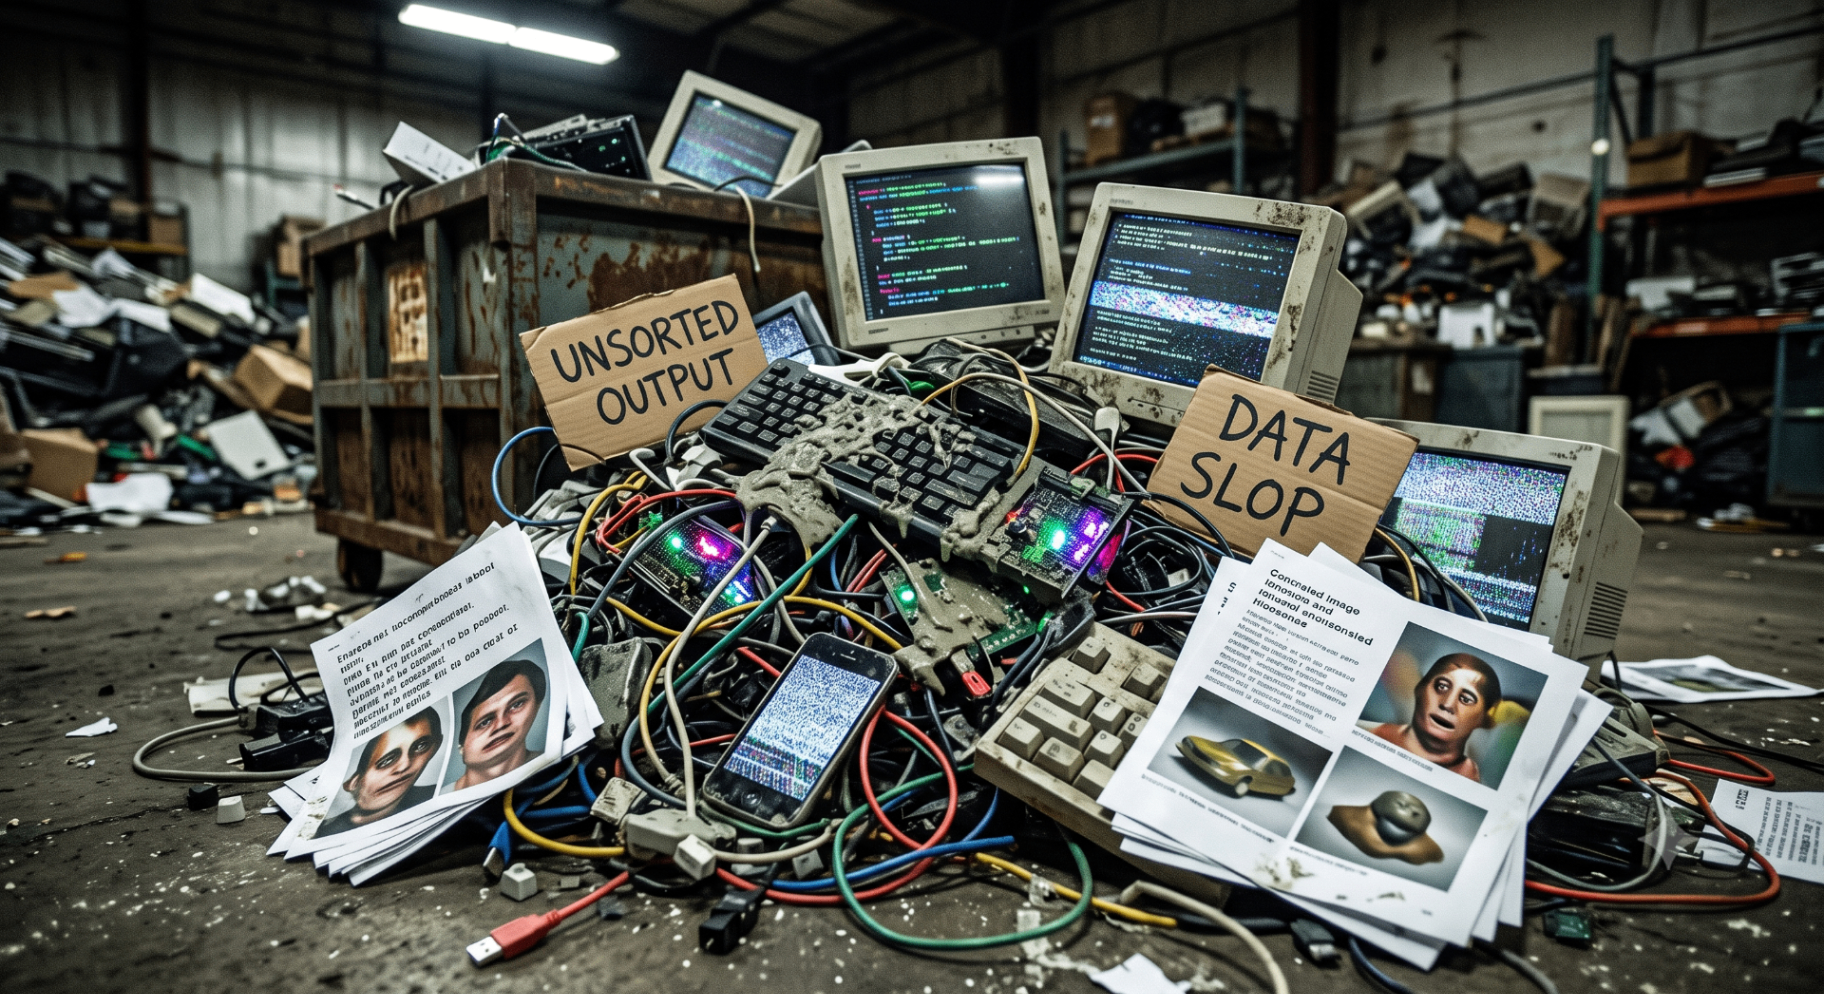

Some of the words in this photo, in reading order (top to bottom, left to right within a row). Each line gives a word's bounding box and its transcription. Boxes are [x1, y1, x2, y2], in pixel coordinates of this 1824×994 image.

[551, 300, 738, 383] UNSORTED
[597, 348, 734, 425] OUTPUT
[1219, 393, 1350, 486] DATA
[1180, 452, 1325, 537] SLOP
[1312, 602, 1334, 616] and
